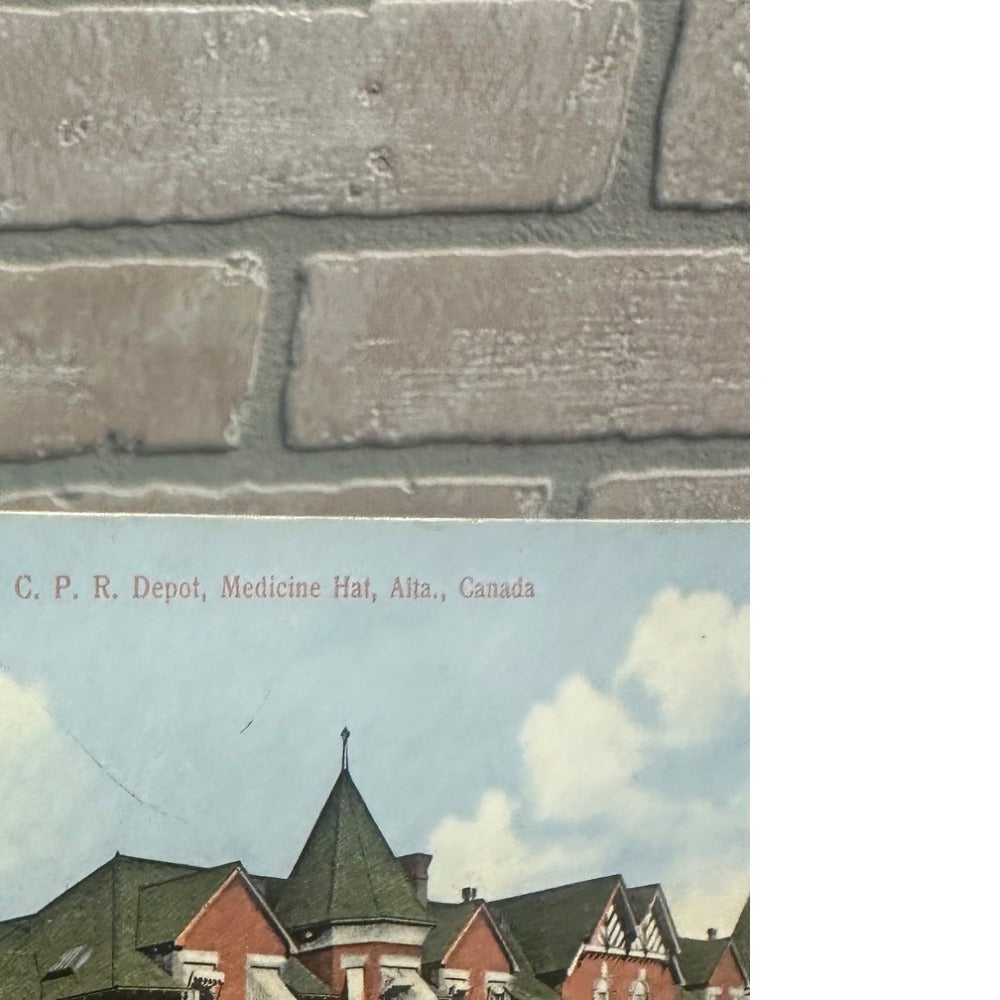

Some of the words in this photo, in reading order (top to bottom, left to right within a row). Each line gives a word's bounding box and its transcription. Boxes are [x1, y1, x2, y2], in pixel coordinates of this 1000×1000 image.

[13, 574, 40, 600] C.
[54, 574, 79, 600] P.
[93, 574, 119, 600] R.
[132, 574, 207, 603] Depot,
[220, 574, 321, 599] Medicine
[333, 575, 378, 603] Hat,
[458, 576, 536, 599] Canada
